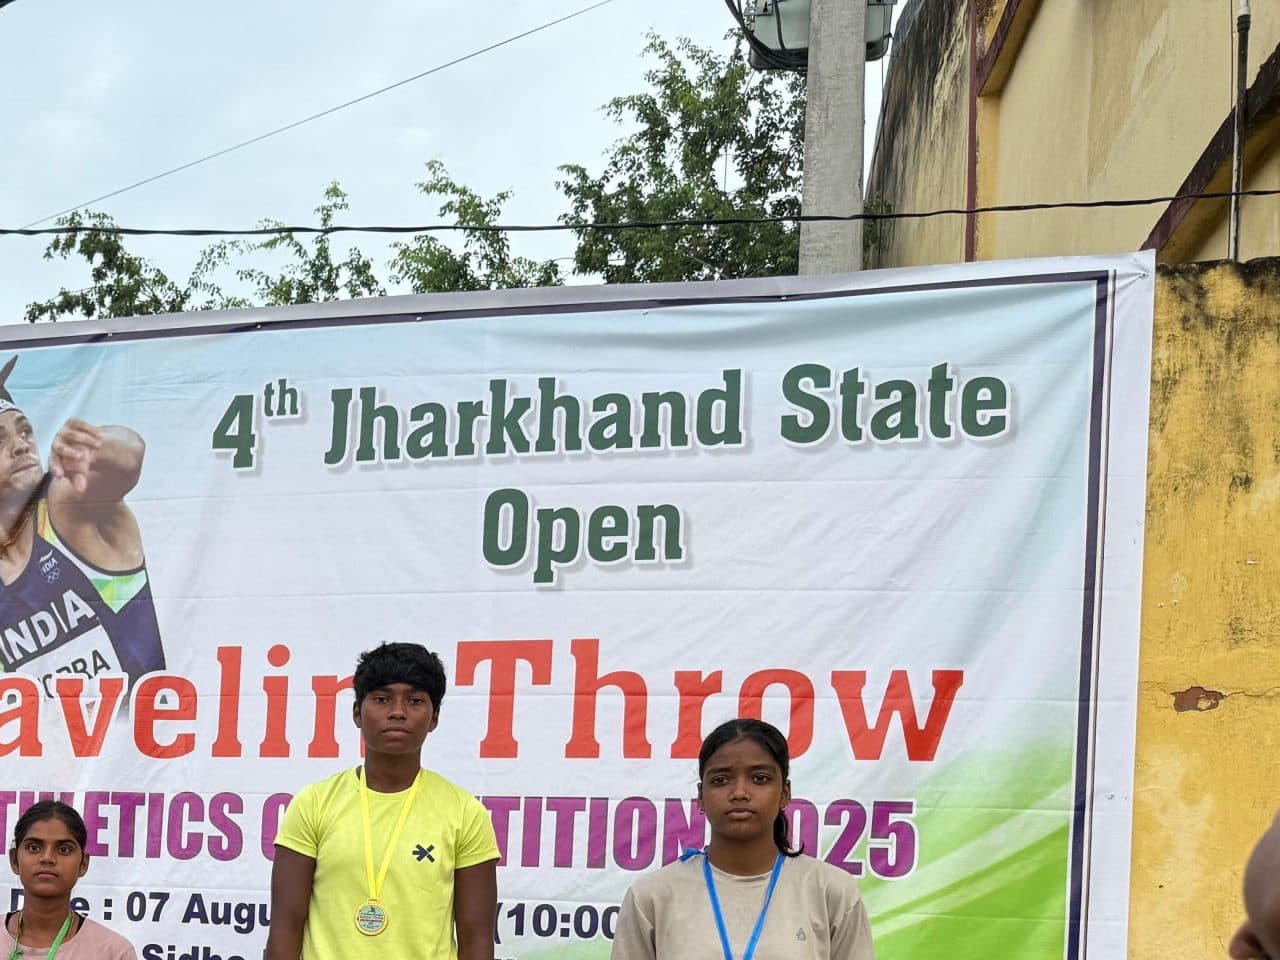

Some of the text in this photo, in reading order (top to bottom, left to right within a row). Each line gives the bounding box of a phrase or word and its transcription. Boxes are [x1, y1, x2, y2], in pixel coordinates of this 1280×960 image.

[212, 362, 1008, 468] 4th Jharkhand State
[482, 488, 683, 584] Open
[455, 638, 964, 762] Throw
[783, 798, 916, 878] 025
[126, 891, 170, 922] 07
[181, 893, 271, 934] Augu
